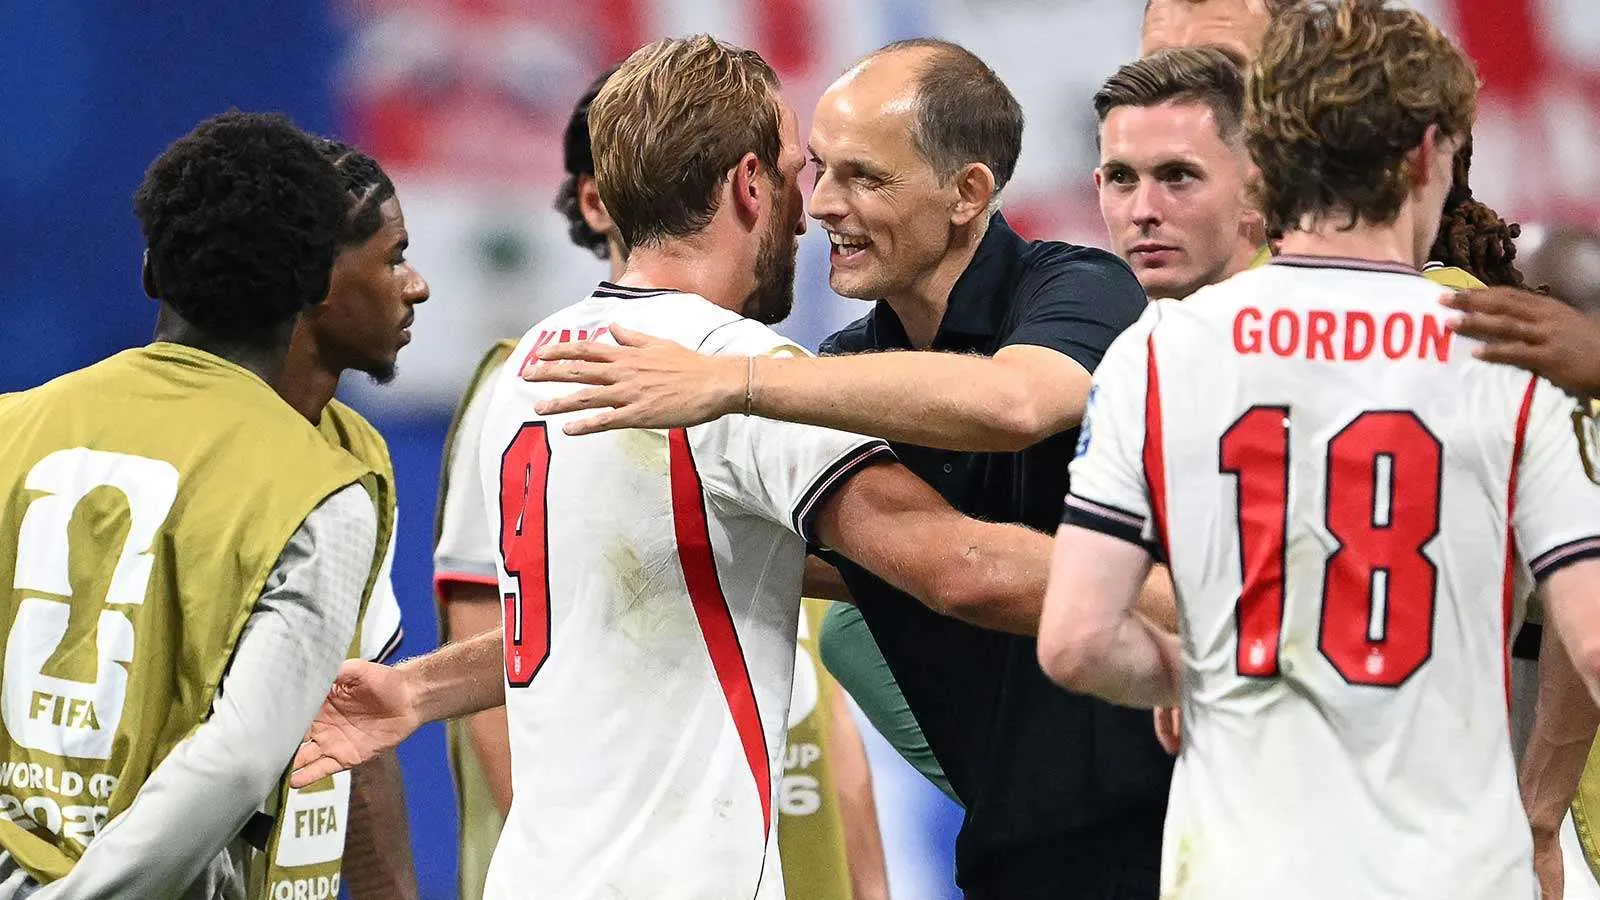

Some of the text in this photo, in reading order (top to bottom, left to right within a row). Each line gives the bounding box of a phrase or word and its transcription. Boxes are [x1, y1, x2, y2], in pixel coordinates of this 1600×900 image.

[1233, 307, 1452, 363] GORDON
[499, 420, 552, 689] 9
[1219, 404, 1442, 687] 18
[29, 690, 100, 730] FIFA
[783, 743, 821, 770] UP
[0, 762, 118, 800] WORLD CP
[294, 805, 338, 839] FIFA
[268, 876, 330, 900] ORLD
